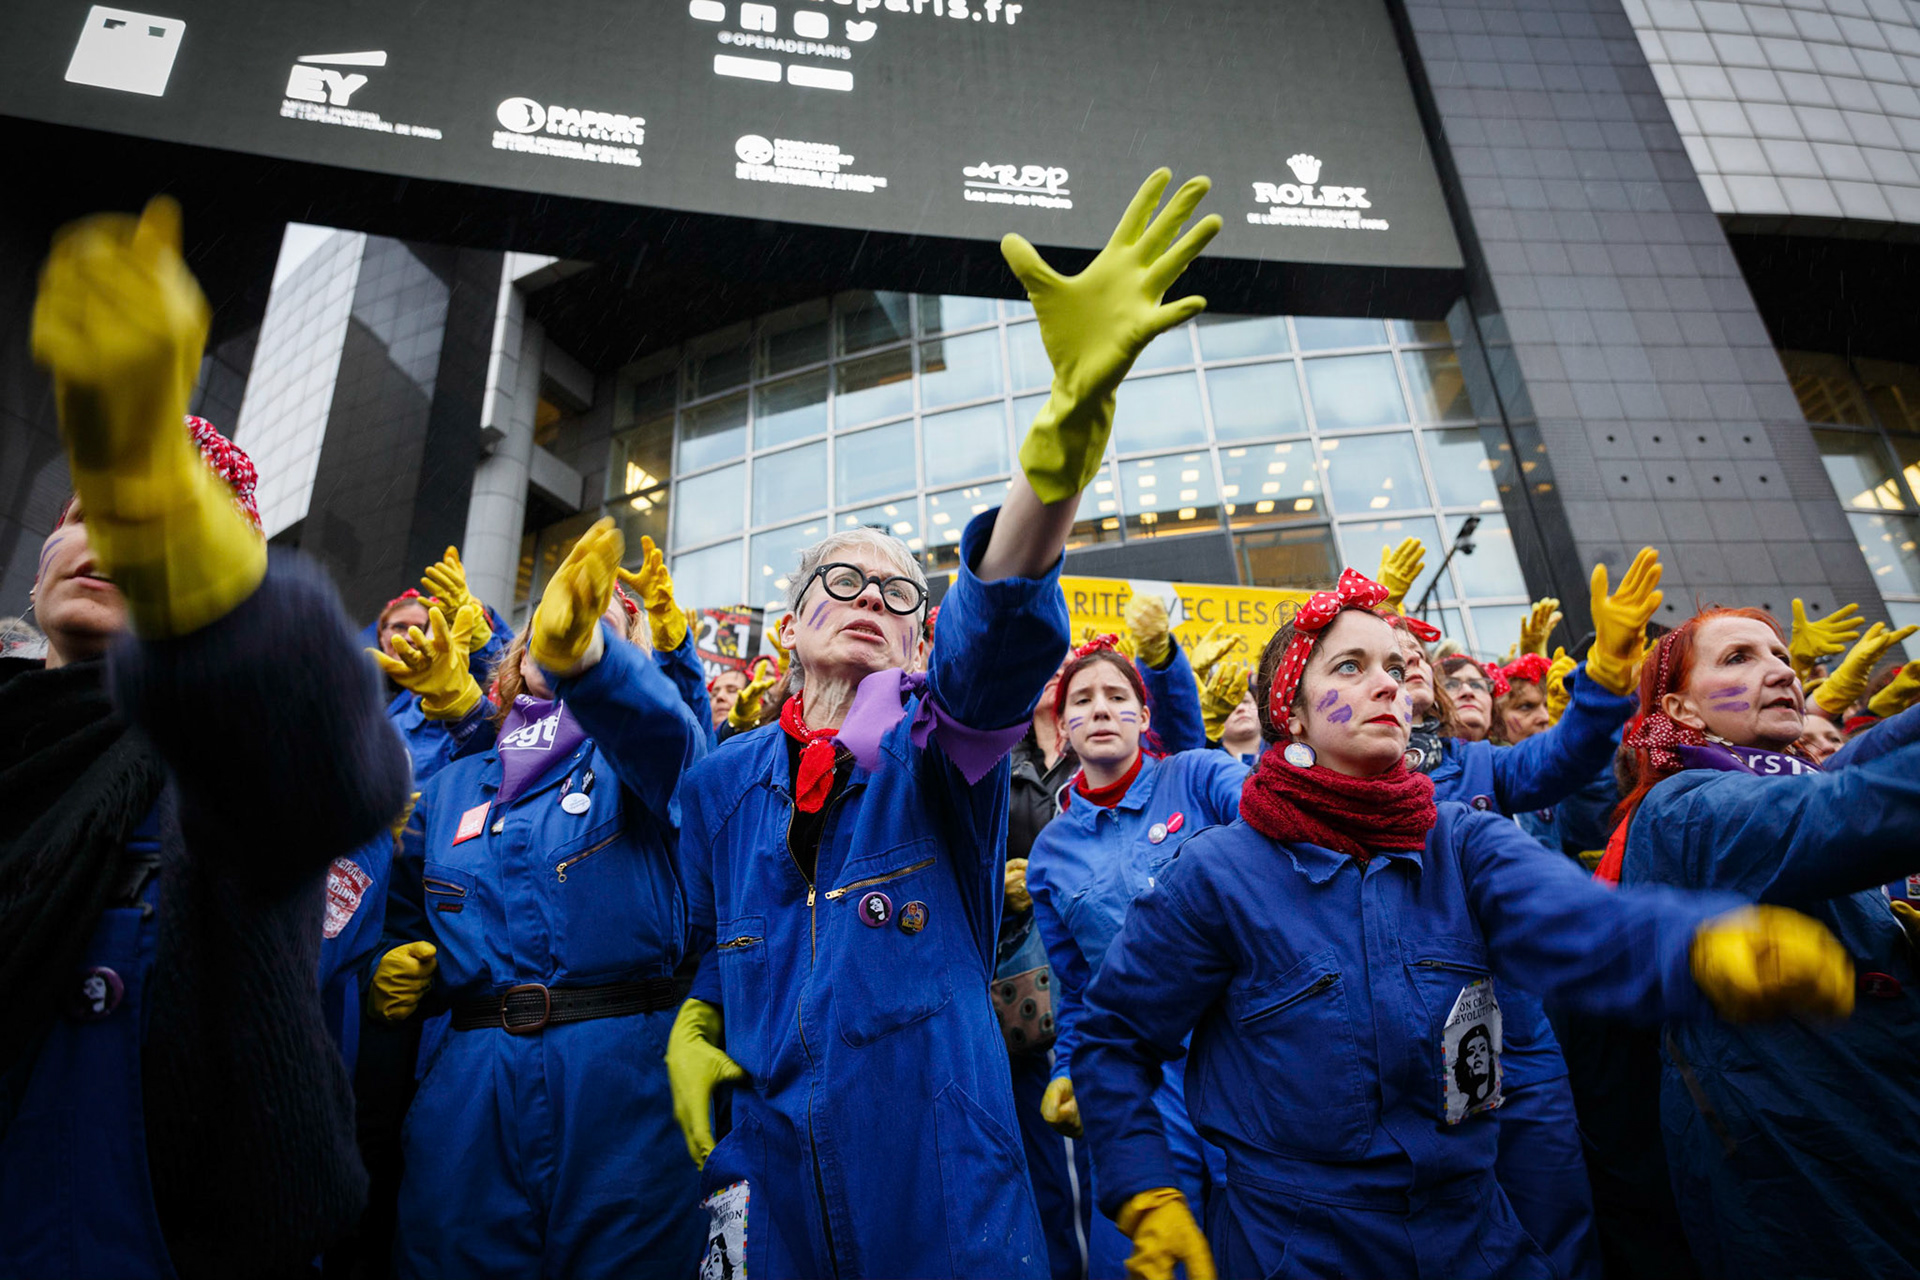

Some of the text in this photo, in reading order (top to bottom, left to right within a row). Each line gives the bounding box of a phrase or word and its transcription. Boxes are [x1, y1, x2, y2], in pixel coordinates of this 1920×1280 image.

[717, 30, 852, 60] @OPERADEPARIS
[285, 64, 368, 106] EY
[547, 105, 646, 136] PAPREC
[1252, 182, 1372, 208] ROLEX
[1069, 587, 1131, 618] RITÉ
[1163, 597, 1215, 622] VEC
[1225, 599, 1269, 625] LES
[501, 714, 558, 748] cgt
